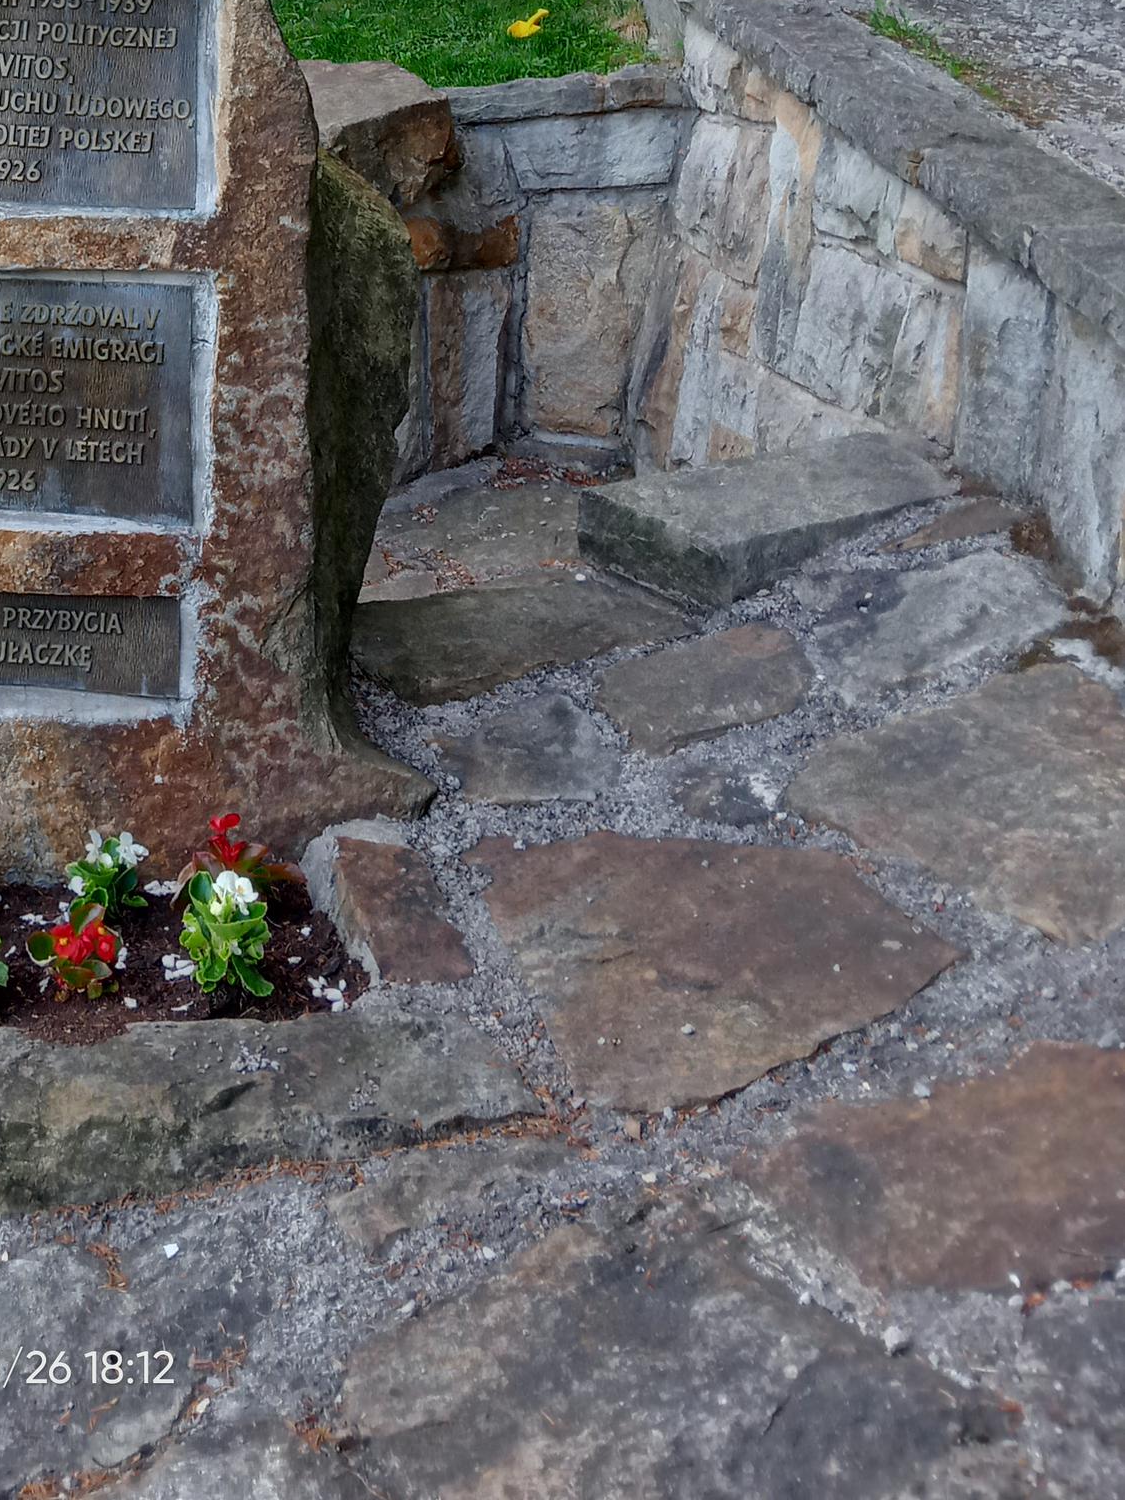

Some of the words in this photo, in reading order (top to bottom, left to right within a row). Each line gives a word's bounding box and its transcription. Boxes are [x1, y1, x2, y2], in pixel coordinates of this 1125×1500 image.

[37, 21, 177, 48] POLITYCZNEJ
[64, 94, 194, 128] LUDOWEGO,
[144, 307, 161, 330] V
[51, 338, 165, 364] EMIGRACI
[42, 437, 60, 460] V
[3, 607, 123, 634] PRZYBYCIA
